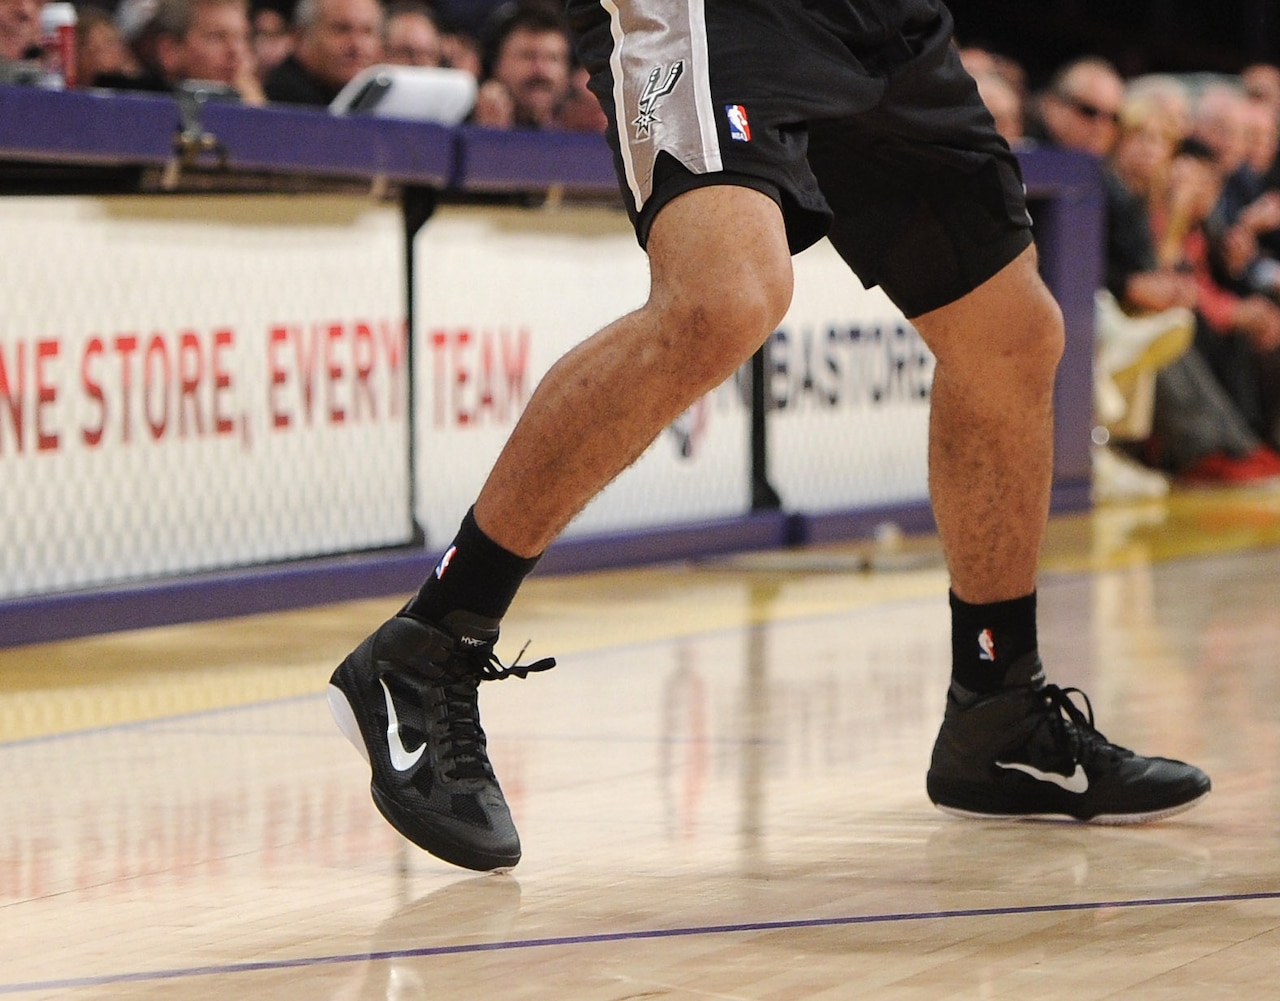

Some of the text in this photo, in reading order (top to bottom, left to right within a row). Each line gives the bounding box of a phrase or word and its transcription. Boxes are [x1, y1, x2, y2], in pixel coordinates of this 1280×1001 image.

[81, 326, 252, 452] STORE,
[266, 318, 412, 432] EVERY
[427, 323, 532, 428] TEAM
